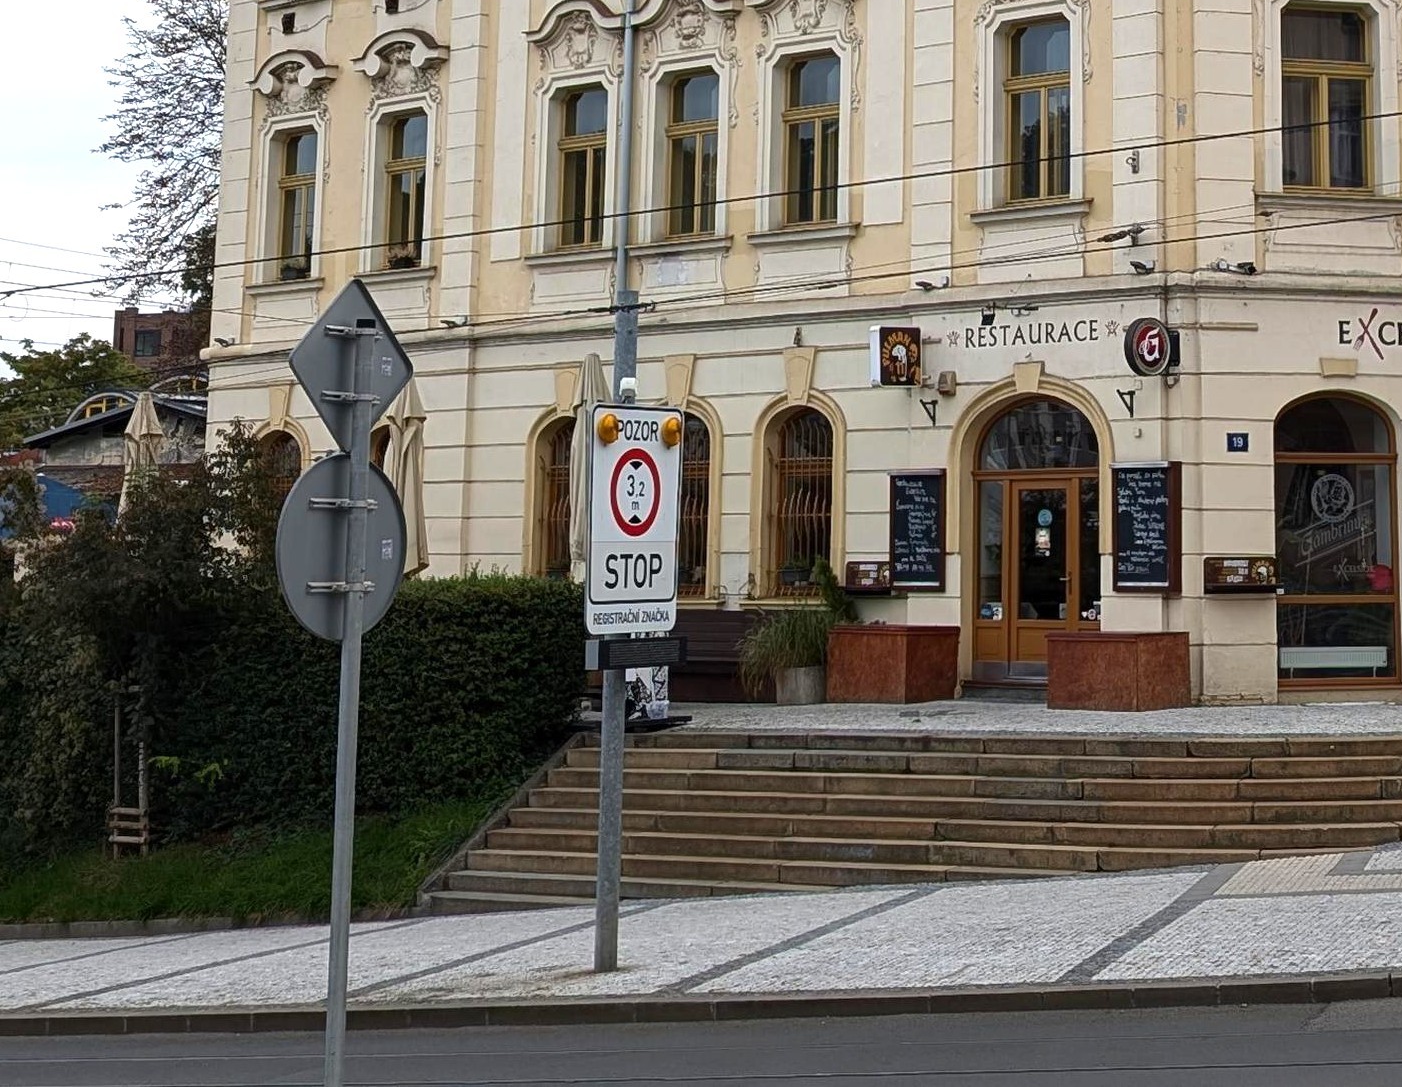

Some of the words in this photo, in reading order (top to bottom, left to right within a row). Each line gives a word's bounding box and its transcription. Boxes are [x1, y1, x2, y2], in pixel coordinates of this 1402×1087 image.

[965, 319, 1099, 349] RESTAURACE
[617, 419, 659, 442] POZOR
[1232, 436, 1244, 448] 19
[626, 474, 646, 499] 3,2
[631, 500, 640, 511] m
[604, 553, 663, 590] STOP
[593, 609, 640, 626] REGISTRAČNÍ
[641, 607, 670, 624] ZNAČKA
